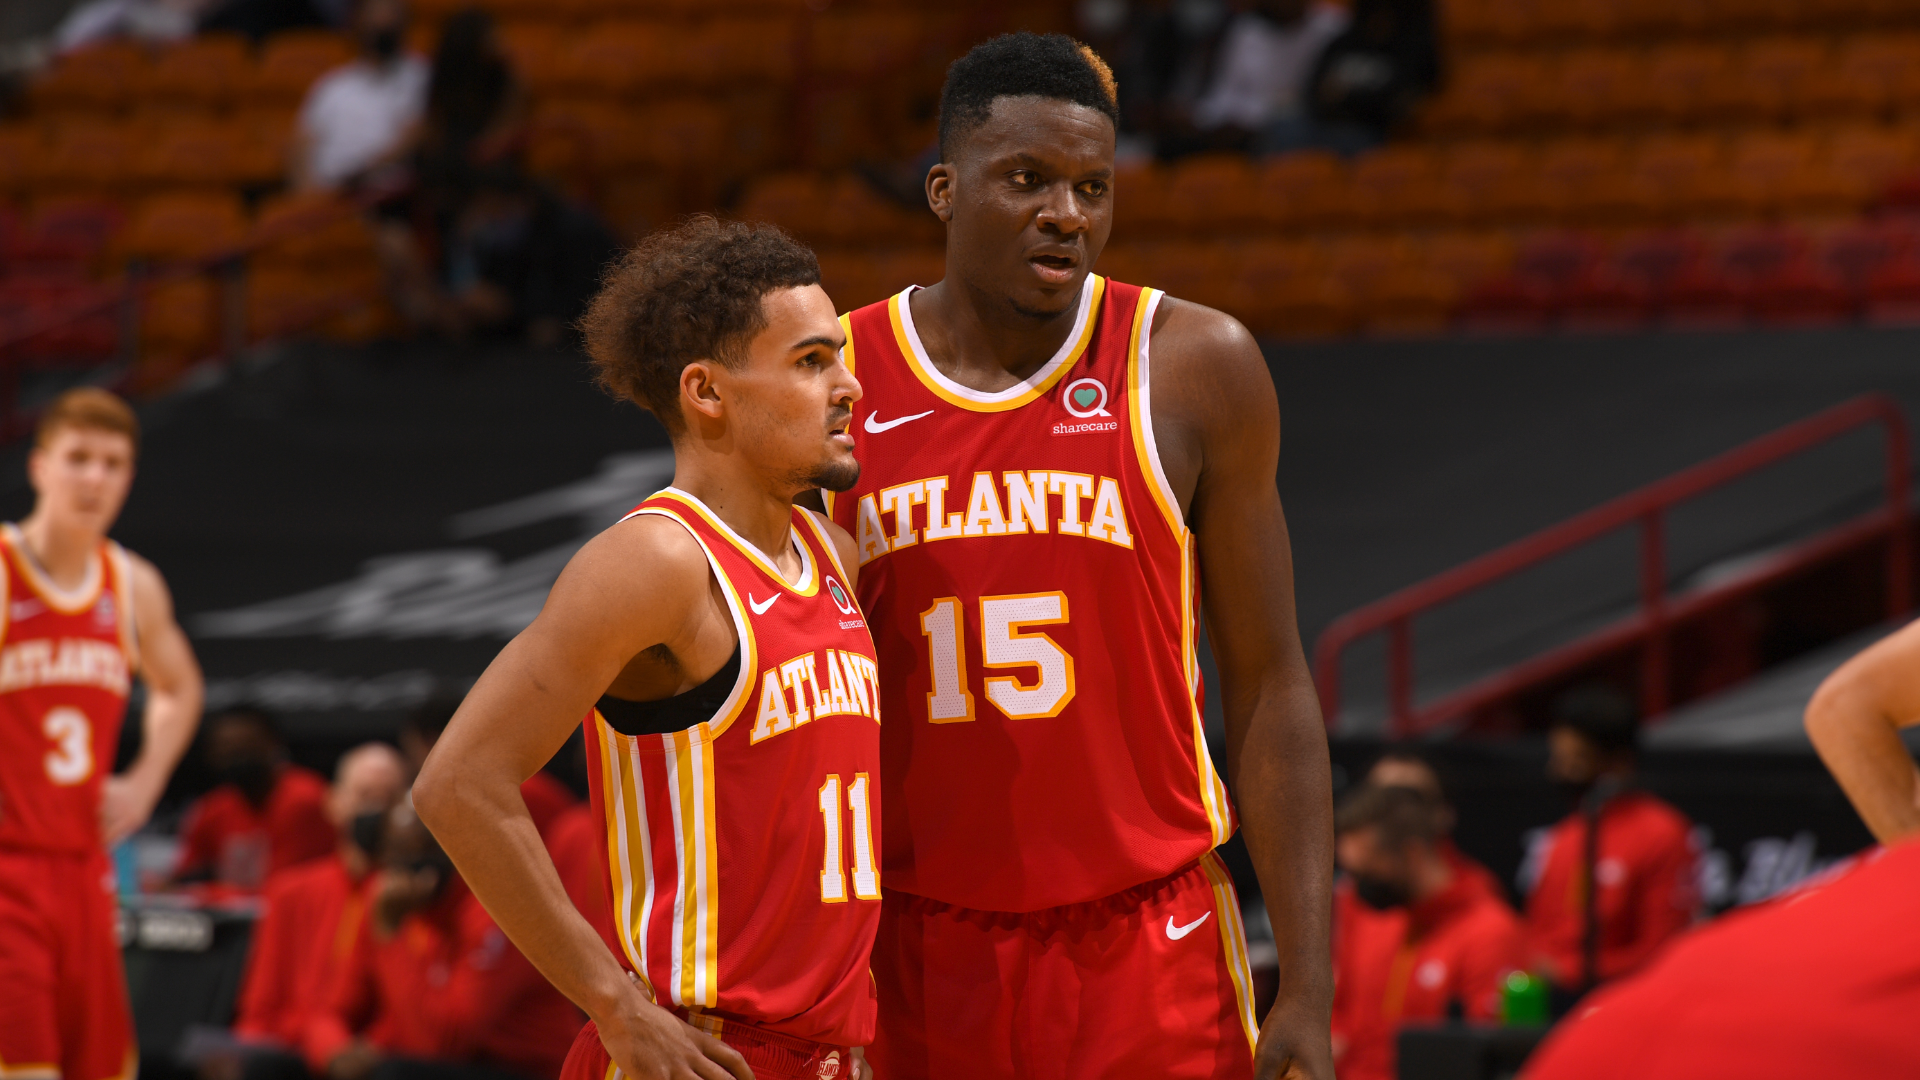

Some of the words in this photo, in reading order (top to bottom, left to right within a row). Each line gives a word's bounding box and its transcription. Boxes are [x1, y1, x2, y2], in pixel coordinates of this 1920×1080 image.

[1053, 420, 1118, 435] sharecare
[857, 470, 1134, 567] ATLANTA
[750, 648, 881, 746] ATLANT
[920, 591, 1076, 724] 15
[43, 707, 94, 785] 3
[818, 772, 882, 903] 11
